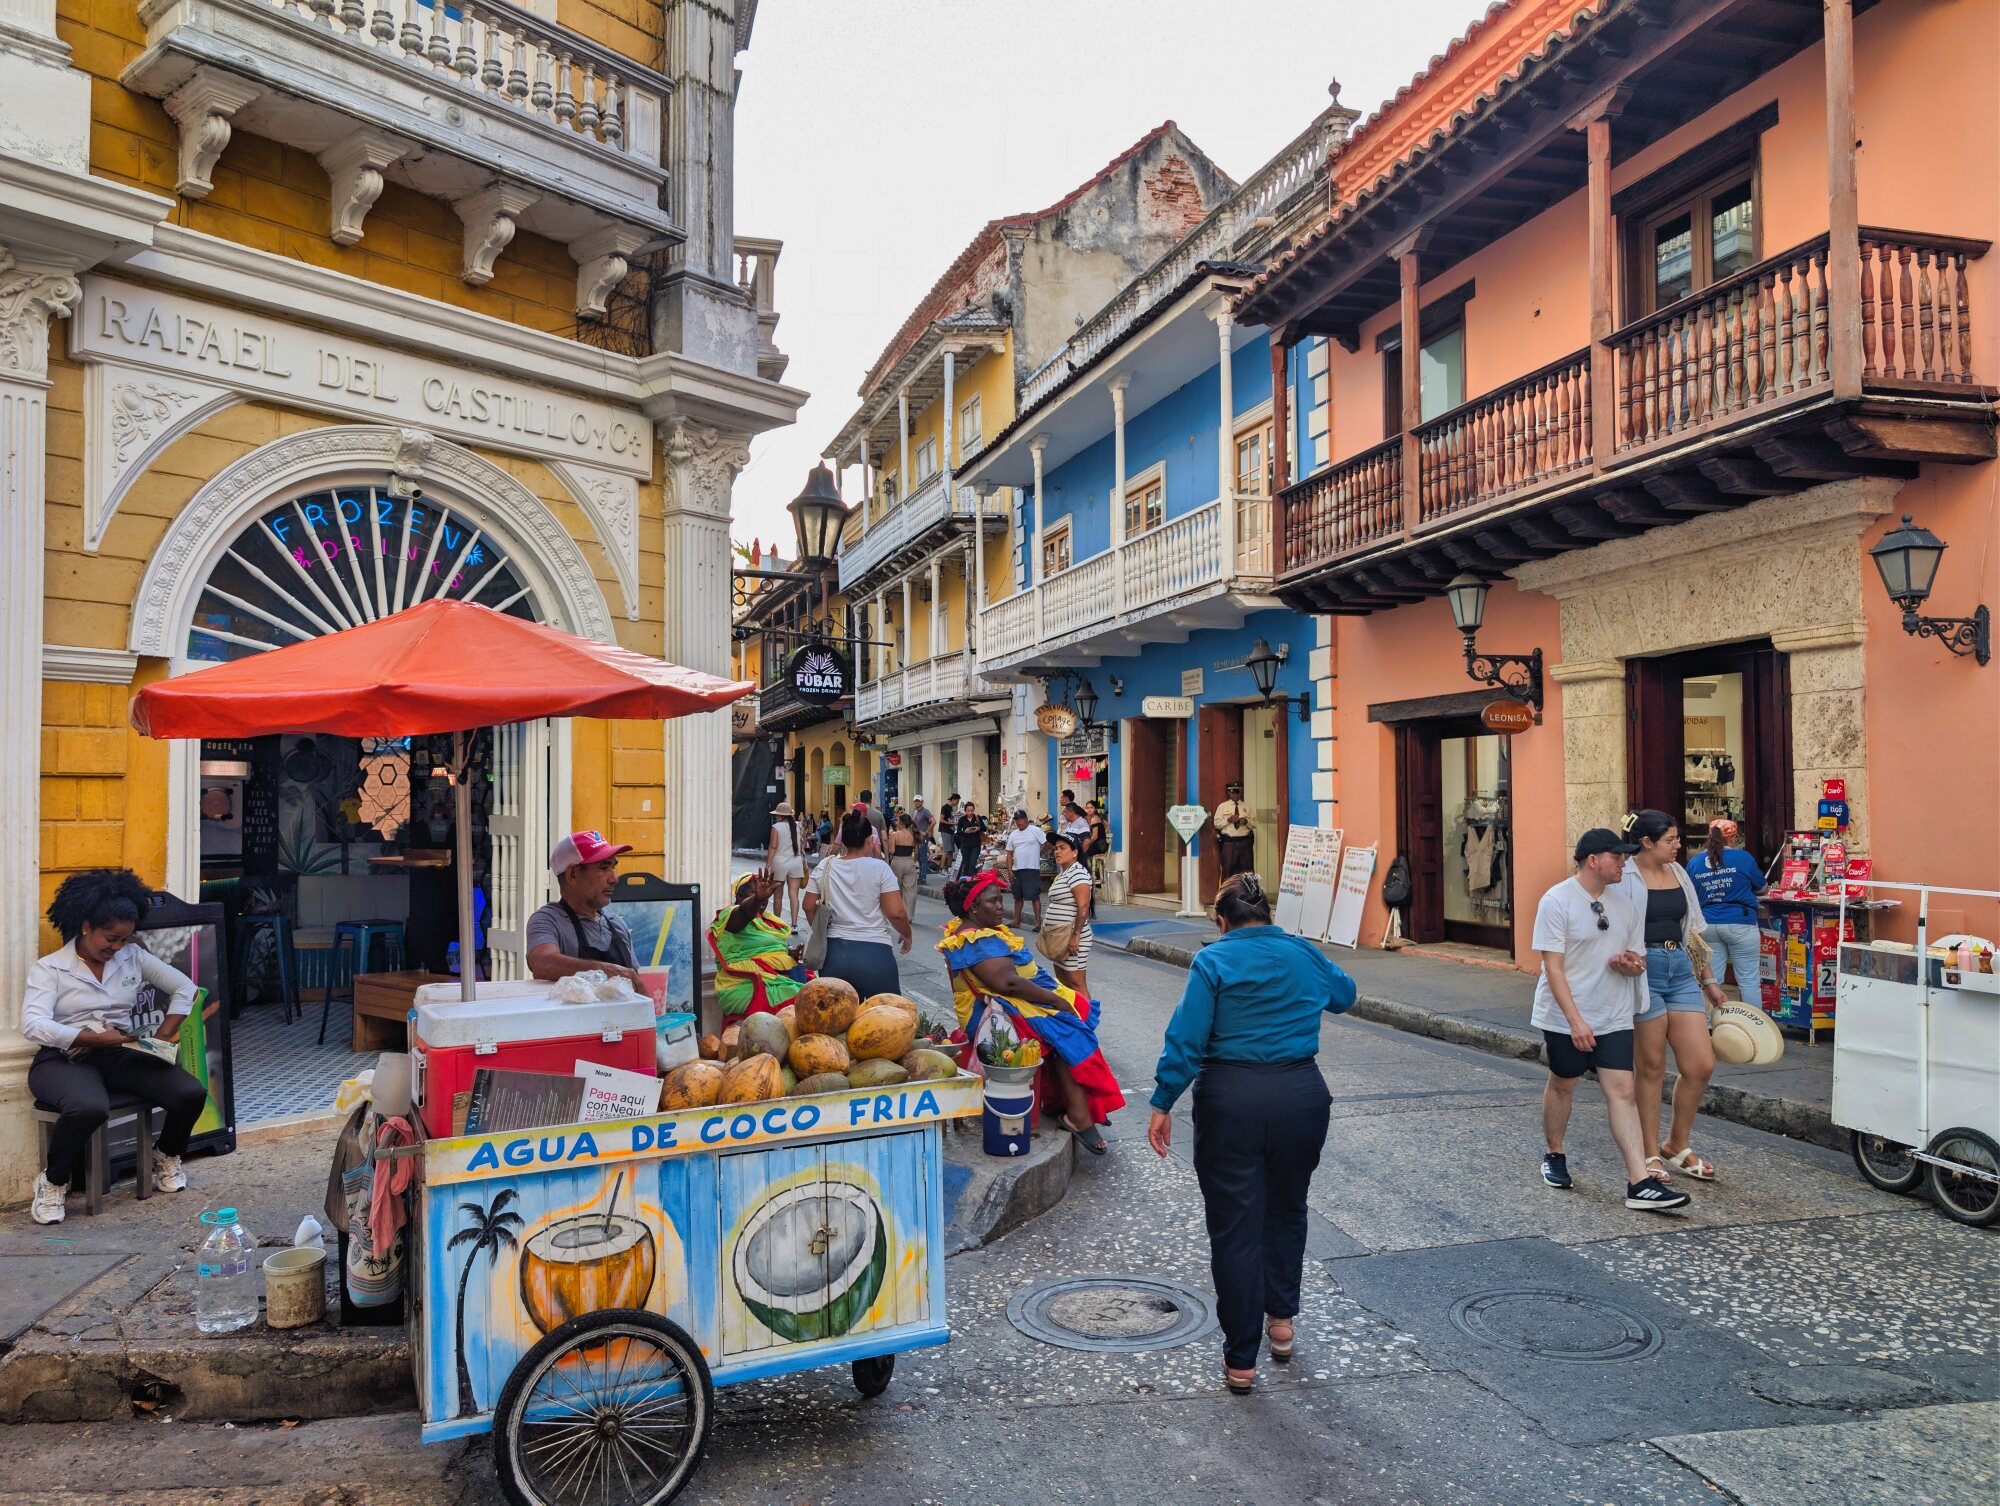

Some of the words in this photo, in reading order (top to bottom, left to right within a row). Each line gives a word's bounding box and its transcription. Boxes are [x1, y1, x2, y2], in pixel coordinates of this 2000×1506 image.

[101, 296, 292, 378] RAFAEL
[318, 348, 400, 403] DEL
[422, 375, 591, 444] CASTILLO
[272, 498, 461, 550] FROZEN
[796, 672, 842, 689] FÜBAR
[1489, 713, 1528, 722] LEONISA
[829, 770, 844, 780] 24
[1848, 867, 1863, 876] Claro
[1720, 1007, 1764, 1026] CARTAGENA
[589, 1087, 618, 1103] Paga
[586, 1101, 608, 1111] con
[610, 1102, 645, 1118] Nequi
[466, 1131, 600, 1173] AGUA
[631, 1124, 679, 1153] DE
[699, 1104, 822, 1144] COCO
[848, 1089, 941, 1126] FRIA
